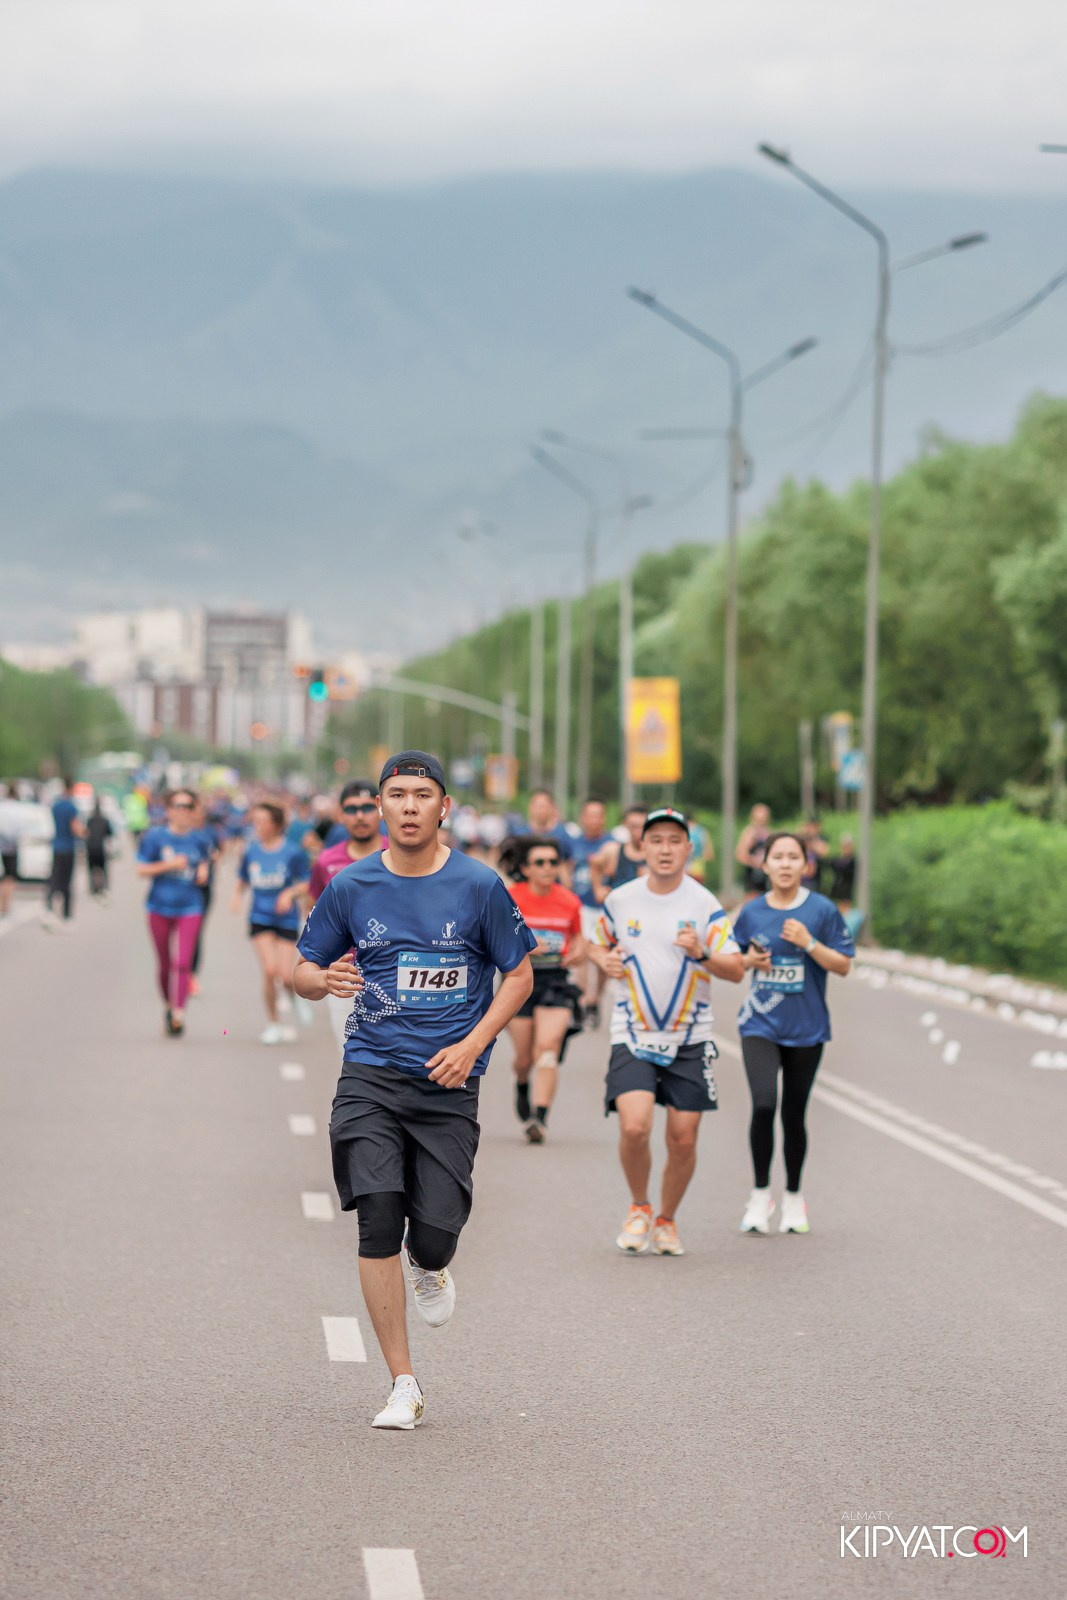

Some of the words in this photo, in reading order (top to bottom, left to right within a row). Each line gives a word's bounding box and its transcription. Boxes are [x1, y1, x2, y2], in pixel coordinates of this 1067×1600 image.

[367, 940, 391, 948] GROUP
[401, 954, 408, 962] 5
[409, 969, 459, 989] 1148
